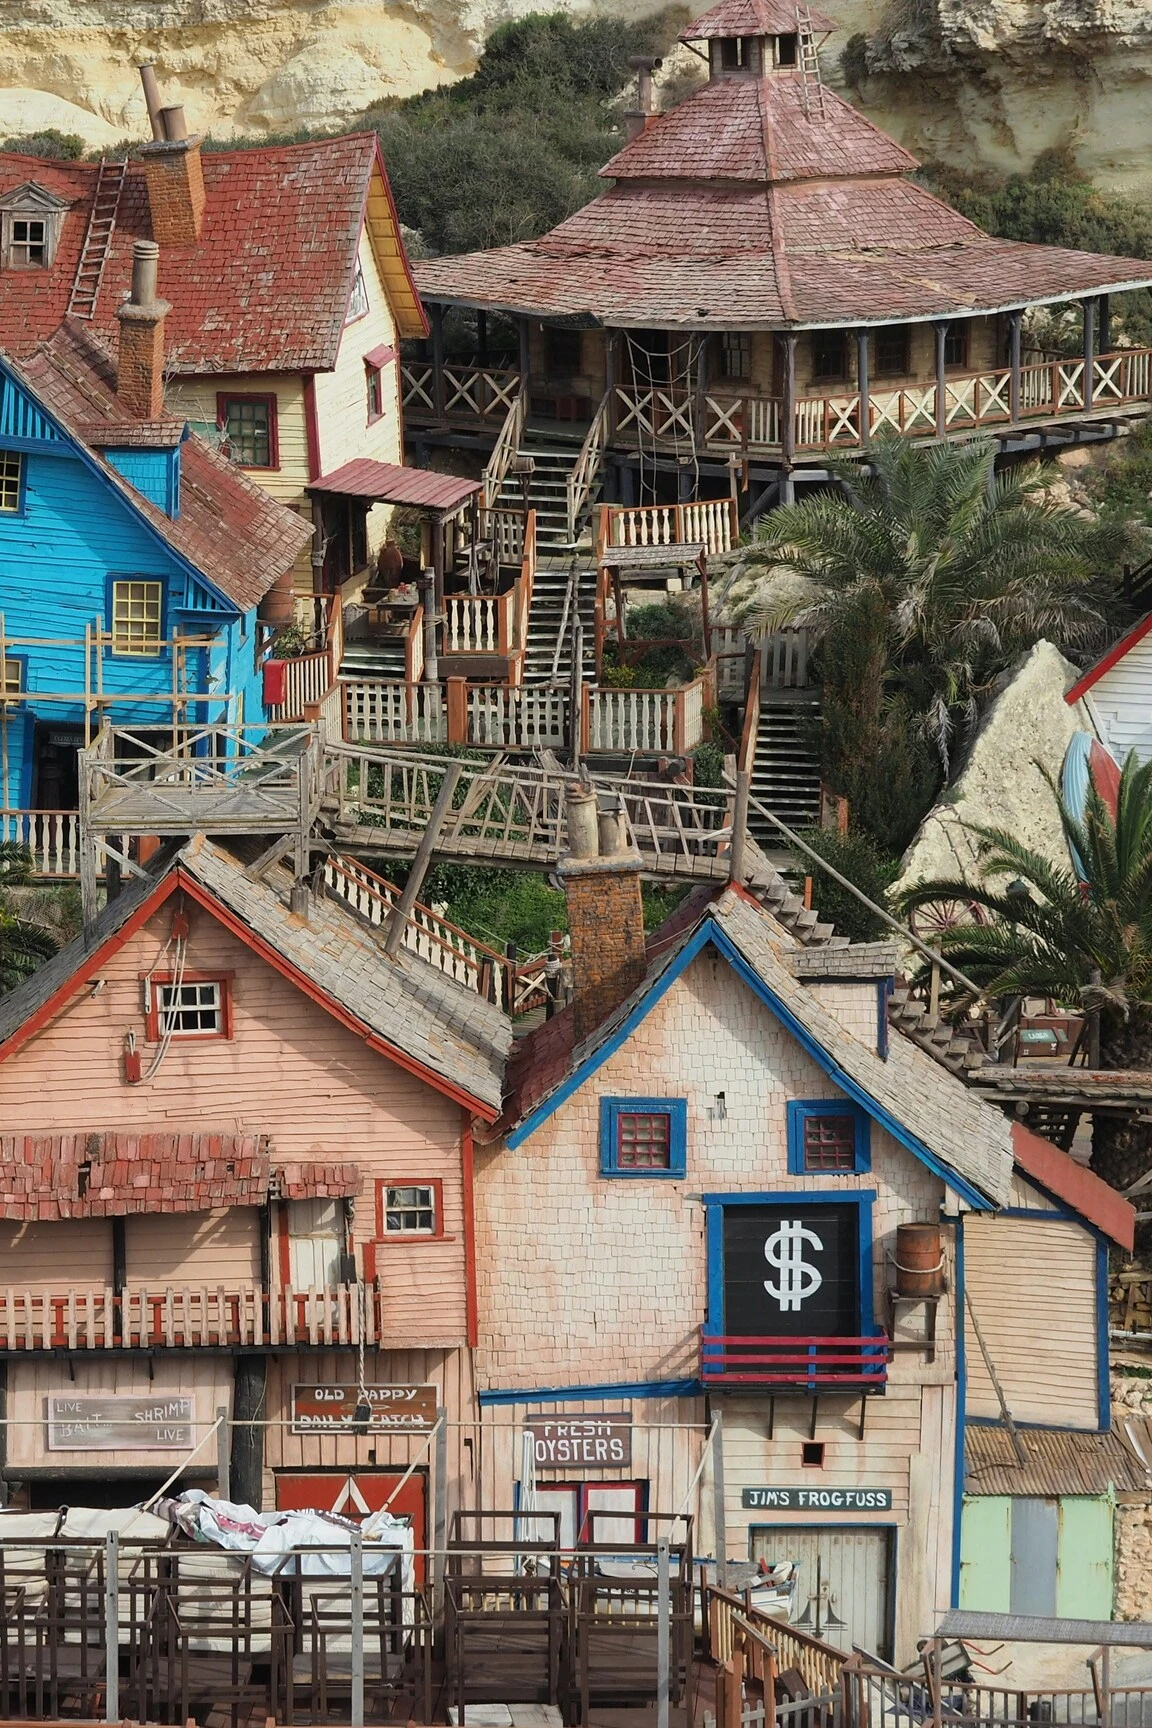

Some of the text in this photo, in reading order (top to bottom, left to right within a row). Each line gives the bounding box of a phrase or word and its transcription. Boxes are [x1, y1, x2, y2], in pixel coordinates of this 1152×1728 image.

[763, 1220, 824, 1311] $
[315, 1389, 345, 1400] OLD
[57, 1402, 83, 1412] LIVE
[135, 1399, 190, 1424] SHRIMP
[300, 1415, 425, 1428] DAILY CATCH
[544, 1421, 611, 1436] FRESH
[157, 1429, 184, 1440] LIVE
[535, 1439, 624, 1461] OYSTERS
[749, 1491, 790, 1505] JIM'S
